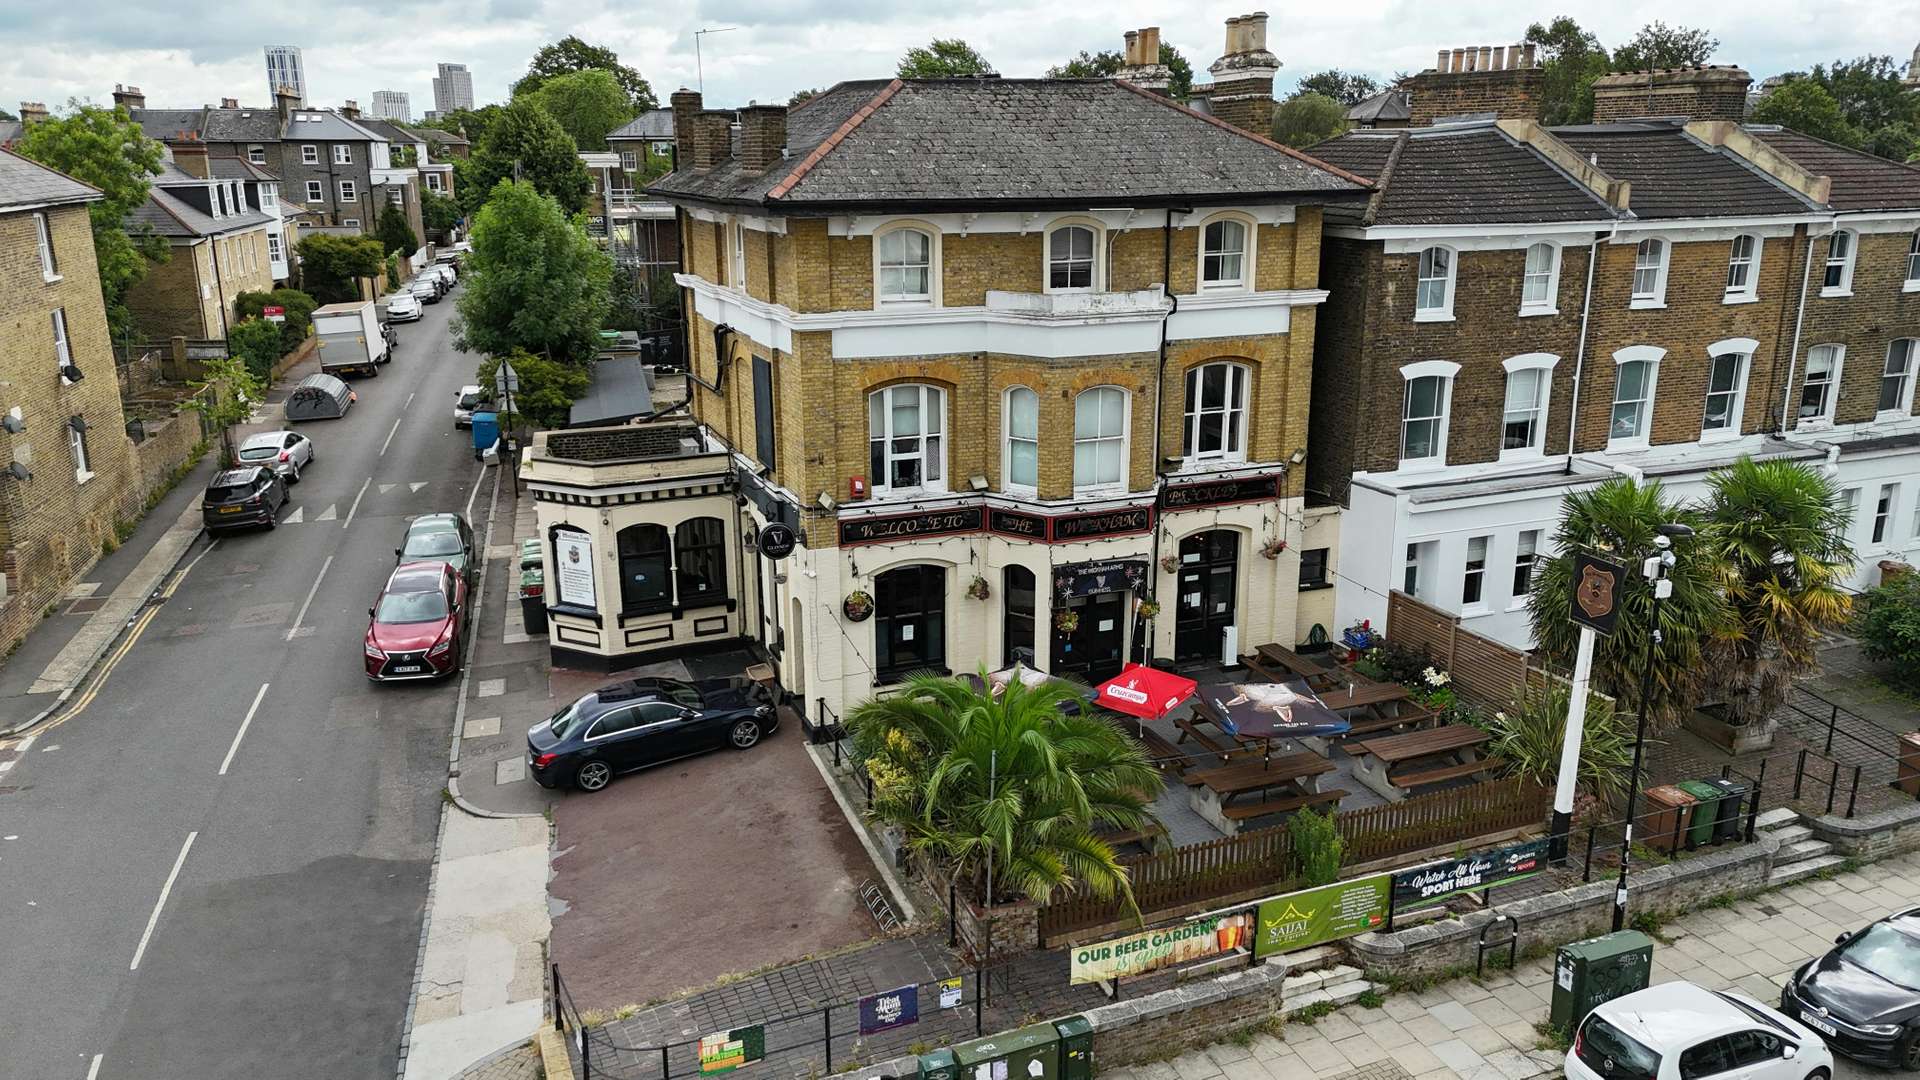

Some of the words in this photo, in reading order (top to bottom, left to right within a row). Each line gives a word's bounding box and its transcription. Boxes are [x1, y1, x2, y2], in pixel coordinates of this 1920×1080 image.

[944, 514, 964, 529] TO
[1412, 870, 1446, 888] Watch
[1448, 862, 1468, 879] All
[1469, 859, 1493, 877] Your
[1421, 879, 1455, 897] SPORT
[1456, 873, 1482, 888] HERE
[1077, 947, 1112, 964] OUR
[1115, 938, 1148, 957] BEER
[1151, 920, 1212, 947] GARDEN
[1134, 943, 1172, 967] open
